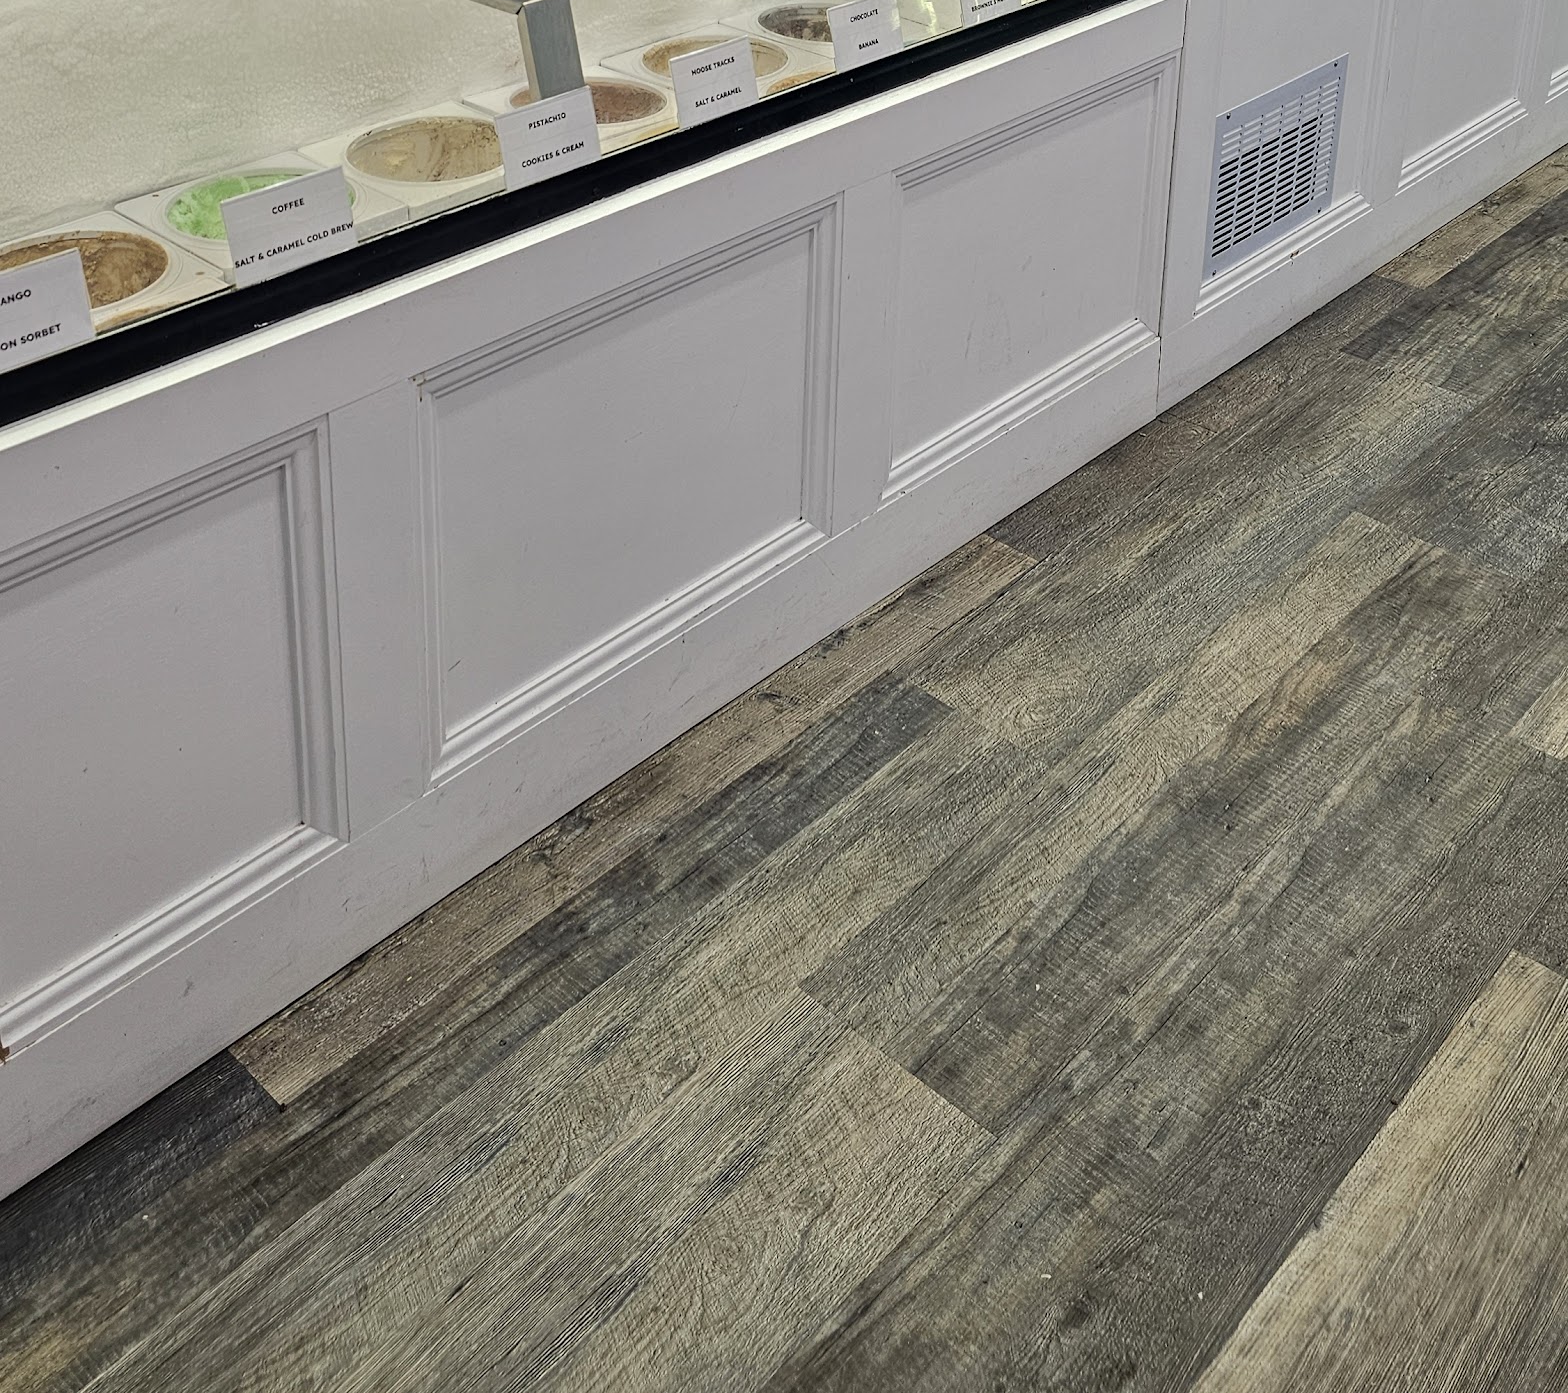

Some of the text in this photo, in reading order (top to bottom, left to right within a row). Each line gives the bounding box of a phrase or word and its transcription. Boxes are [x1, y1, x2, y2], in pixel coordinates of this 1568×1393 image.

[850, 9, 878, 22] CHOCOLATE
[859, 38, 878, 50] BANANA
[691, 56, 735, 76] MOOSE TRACKS
[695, 98, 709, 108] SALT
[716, 87, 742, 100] CARAMEL
[528, 112, 566, 129] PISTACHIO
[521, 152, 554, 168] COOKIES
[561, 141, 584, 154] CREAM
[271, 198, 305, 214] COFFEE
[235, 221, 354, 269] SALT & CARAMEL COLD BREW
[20, 323, 61, 344] SORBET
